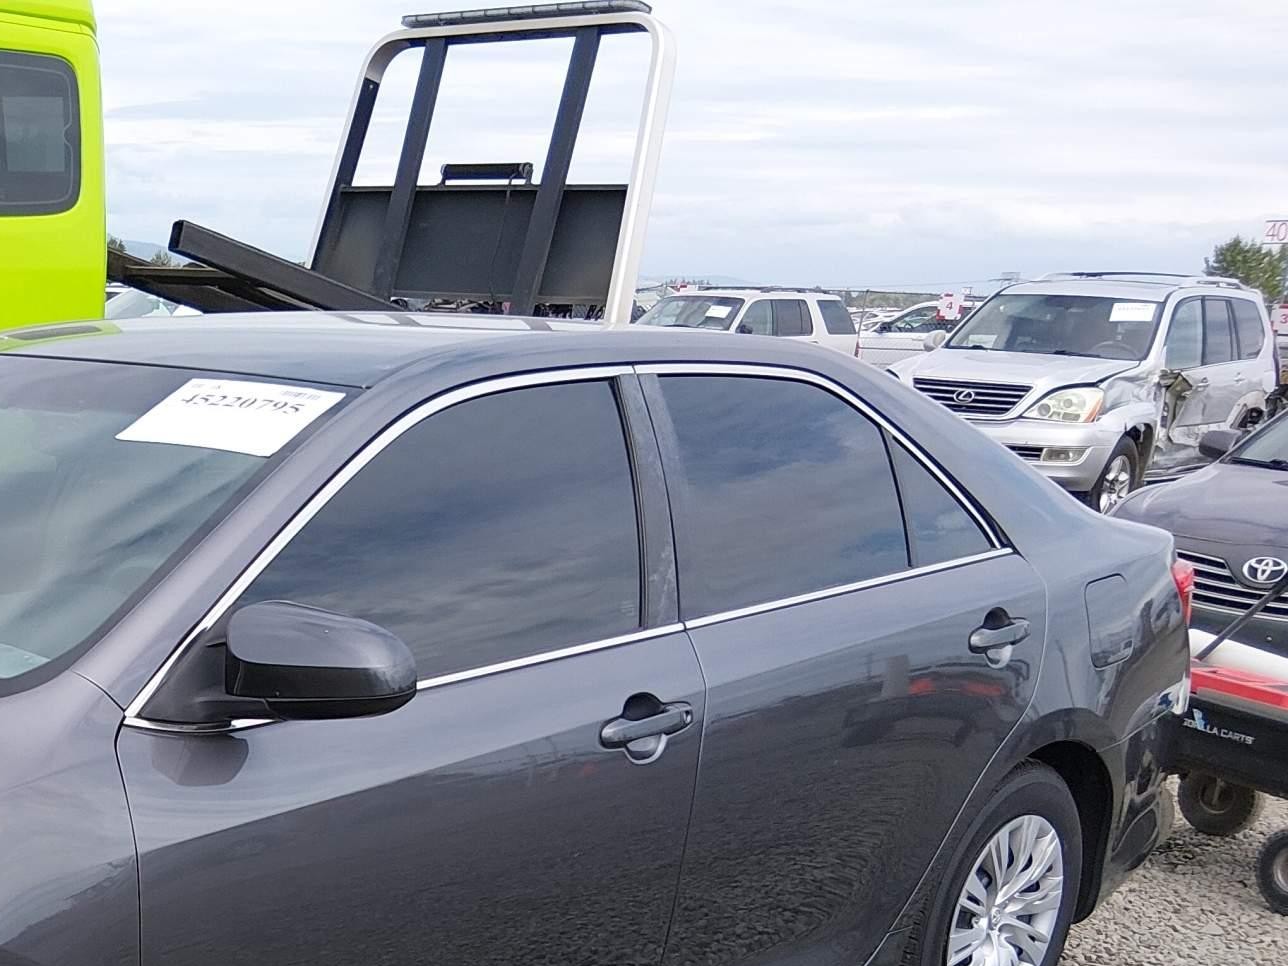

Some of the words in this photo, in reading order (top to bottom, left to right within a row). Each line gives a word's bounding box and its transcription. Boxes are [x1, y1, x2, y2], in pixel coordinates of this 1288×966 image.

[1265, 222, 1288, 241] 40
[945, 301, 954, 310] 4
[181, 393, 305, 415] 45220795
[1220, 728, 1255, 745] CARTS
